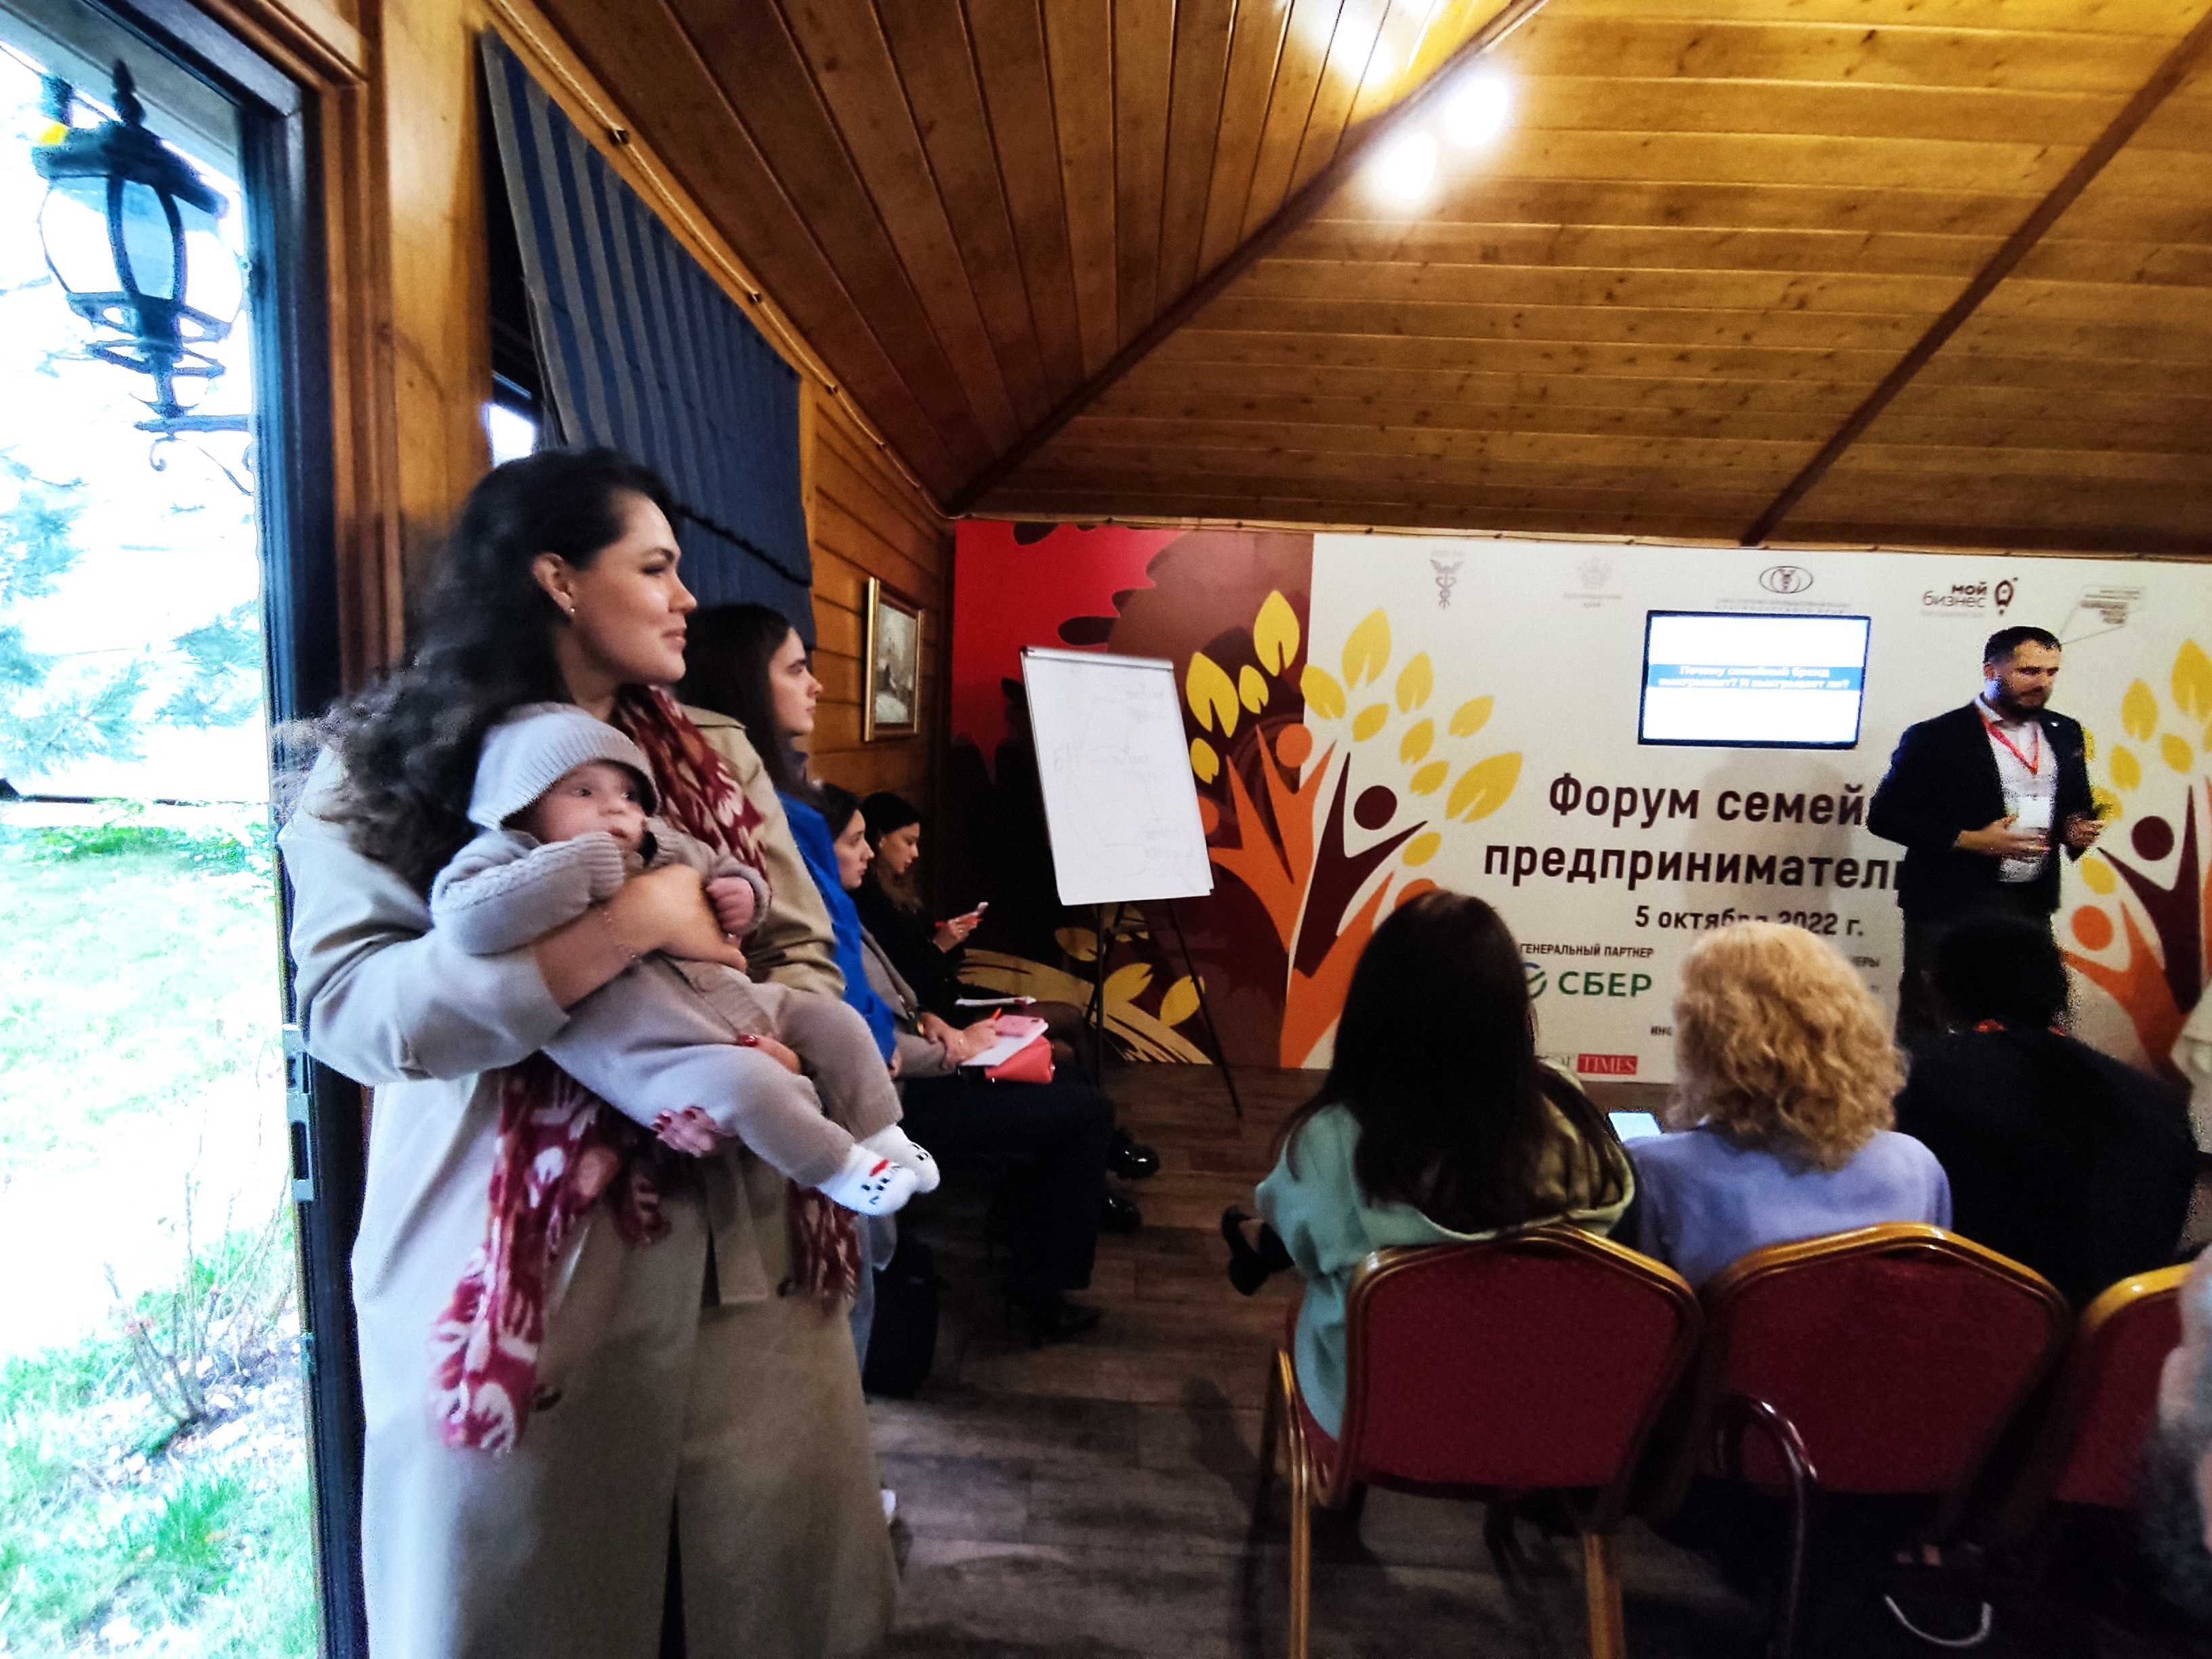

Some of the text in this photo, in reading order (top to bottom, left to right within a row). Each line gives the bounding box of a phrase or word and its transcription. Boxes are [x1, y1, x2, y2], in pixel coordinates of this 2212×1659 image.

[1923, 590, 1986, 608] бизнес
[1549, 772, 1700, 829] Форум
[1635, 905, 1650, 928] 5
[1847, 919, 1864, 936] г.
[1520, 943, 1654, 958] ГЕНЕРАЛЬНЫЙ ПАРТНЕР
[1558, 971, 1652, 998] СБЕР
[1580, 1056, 1635, 1073] TIMES
